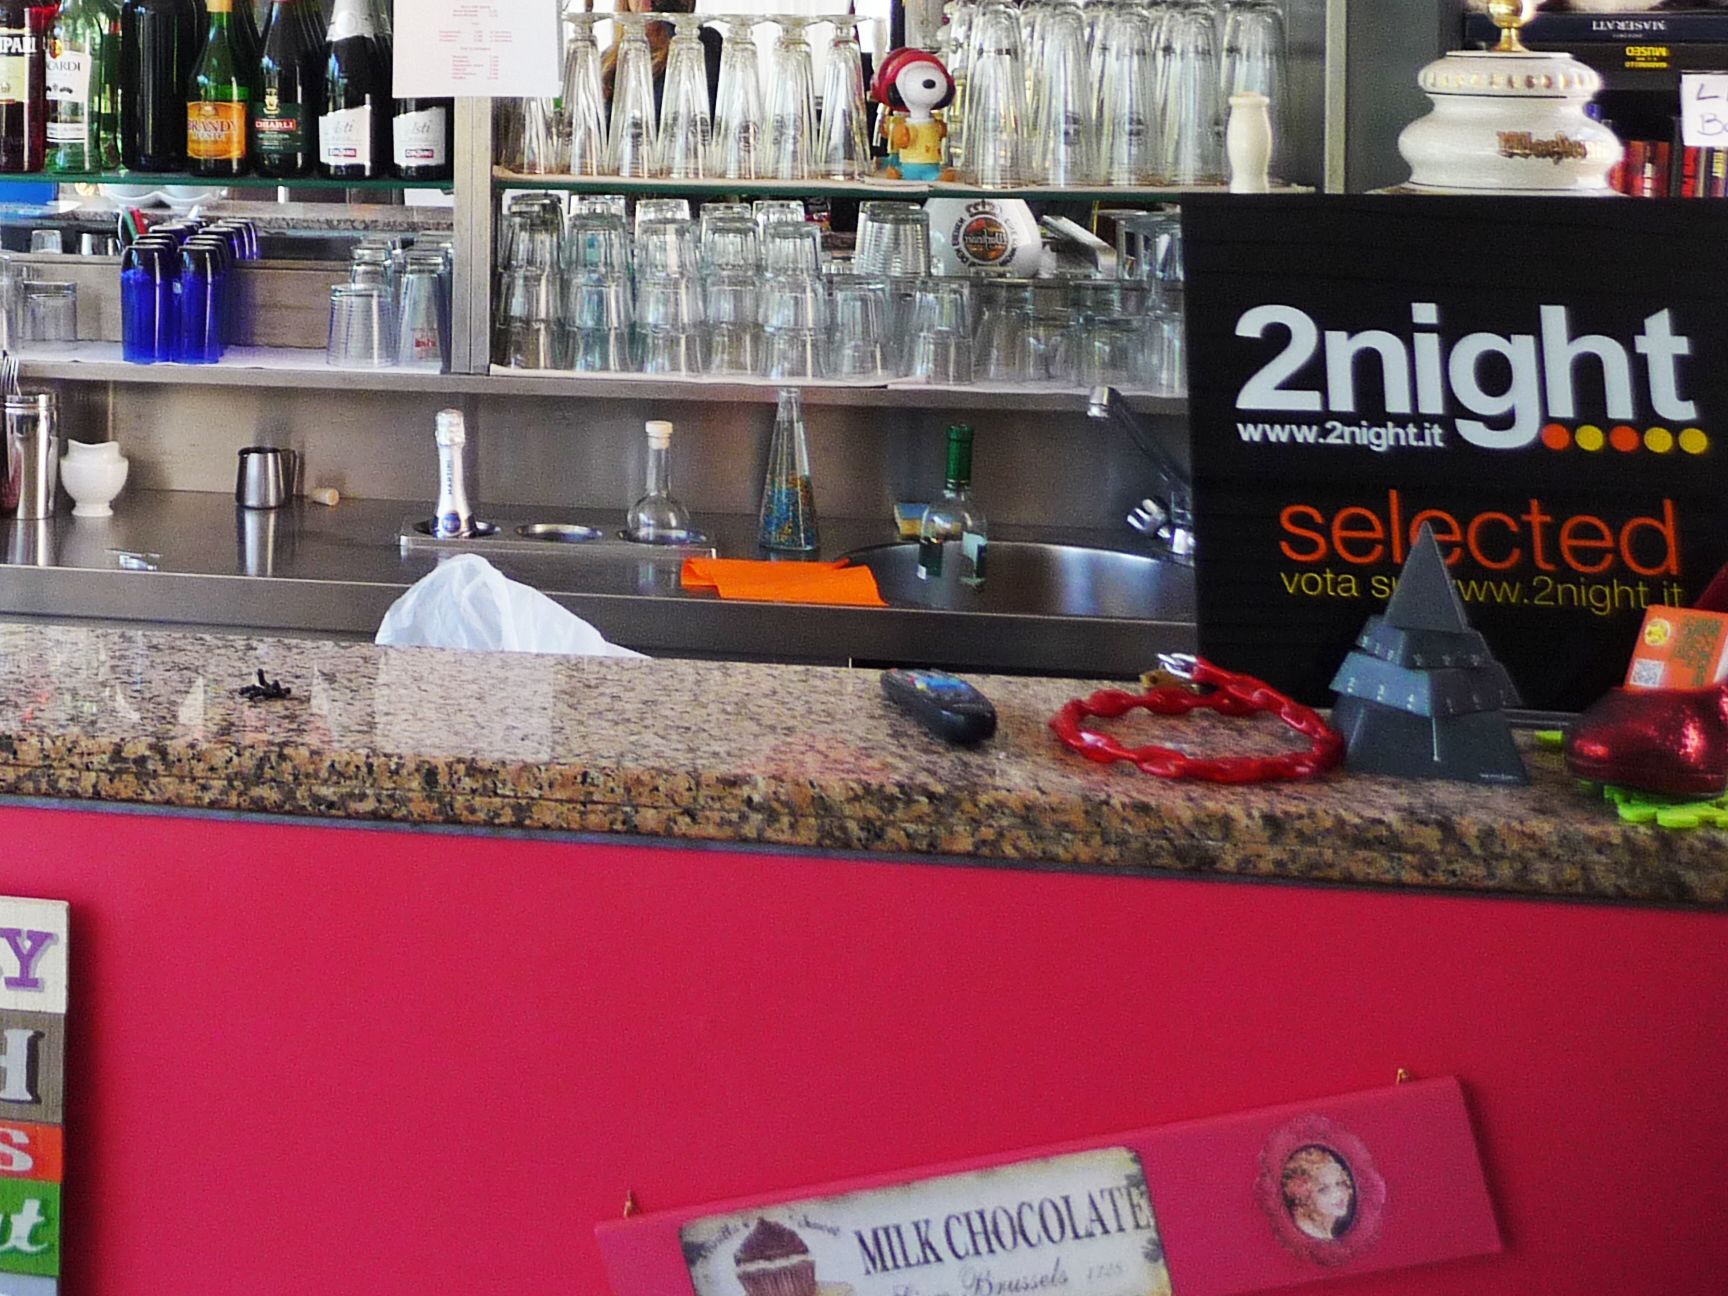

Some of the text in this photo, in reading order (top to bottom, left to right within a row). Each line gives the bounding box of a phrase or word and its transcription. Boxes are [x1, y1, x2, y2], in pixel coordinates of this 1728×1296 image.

[1592, 19, 1666, 31] MASERATI
[47, 61, 81, 72] CARDI
[1626, 46, 1667, 57] MUSEO
[1234, 303, 1697, 449] 2night
[1235, 420, 1446, 452] www.2night.it
[1278, 488, 1680, 576] selected
[1279, 568, 1359, 598] vota
[853, 1183, 1153, 1276] MILK CHOCOLATE
